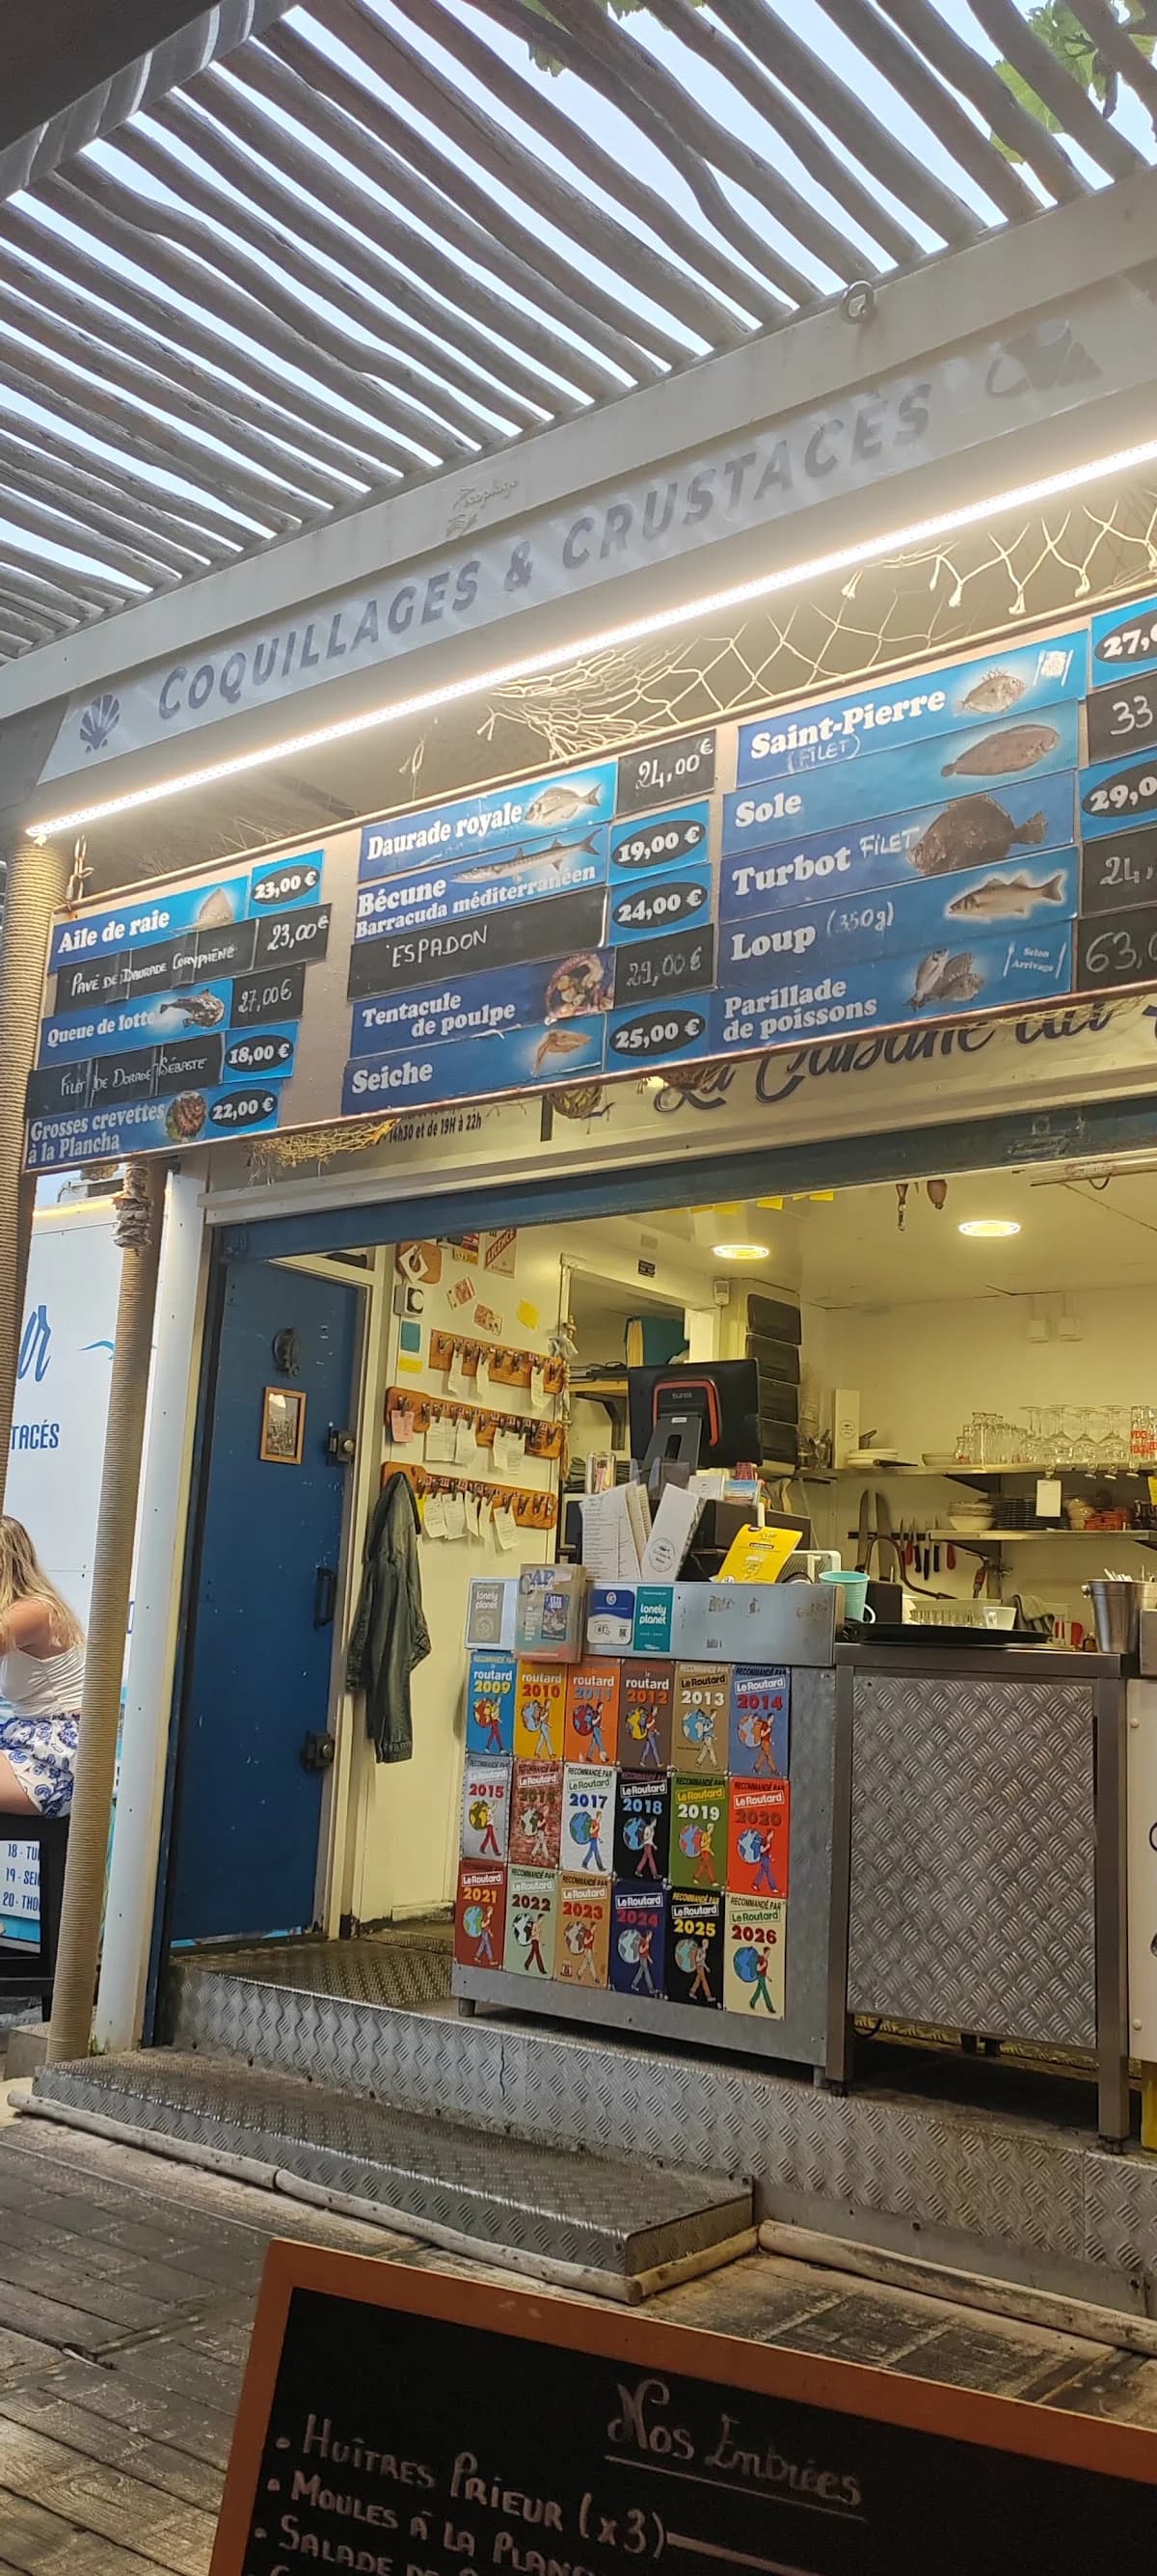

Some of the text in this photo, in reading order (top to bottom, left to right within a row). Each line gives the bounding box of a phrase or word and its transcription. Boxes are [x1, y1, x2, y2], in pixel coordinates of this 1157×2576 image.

[158, 560, 481, 719] COQUILLAGES
[503, 541, 534, 592] &
[1110, 694, 1153, 735] 33
[750, 691, 946, 759] Saint-Pierre
[735, 793, 802, 827] Sole
[367, 801, 522, 860] Daurade royale
[618, 826, 700, 863] 19,00 €
[732, 846, 850, 896] Turbot
[254, 871, 317, 900] 23,00 €
[355, 865, 596, 938] Barracuda méditerranéen
[357, 879, 447, 917] Bécune
[618, 888, 702, 922] 24,00 €
[58, 909, 170, 953] Aile de raie
[392, 925, 488, 967] ESPADON
[731, 926, 816, 961] Loup
[724, 978, 847, 1019] Parillade
[363, 992, 461, 1027] Tentacule
[412, 1004, 516, 1038] de poulpe
[723, 998, 877, 1043] de poissons
[48, 1011, 156, 1048] Queue de lotte
[615, 1018, 700, 1048] 25,00 €
[229, 1044, 290, 1065] 18,00 €
[352, 1061, 433, 1094] Seiche
[212, 1098, 274, 1121] 22,00 €
[30, 1102, 166, 1142] Grosses crevettes
[416, 1124, 425, 1138] et
[427, 1120, 438, 1136] de
[441, 1116, 456, 1134] 19H
[458, 1114, 464, 1131] à
[467, 1112, 482, 1130] 22h
[28, 1131, 120, 1164] à la Plancha
[640, 1604, 666, 1615] lonely
[639, 1615, 666, 1625] planet
[473, 1670, 512, 1681] routard
[522, 1673, 561, 1684] routard
[573, 1676, 614, 1687] routard
[626, 1677, 669, 1690] routard
[681, 1674, 726, 1689] Le Routard
[473, 1680, 511, 1695] 2009
[523, 1684, 560, 1697] 2010
[575, 1687, 612, 1701] 2011
[737, 1678, 784, 1693] Le Routard
[627, 1690, 669, 1705] 2012
[681, 1690, 725, 1706] 2013
[737, 1695, 783, 1711] 2014
[519, 1774, 556, 1786] Le Routard
[569, 1777, 610, 1791] Le Routard
[469, 1783, 504, 1799] 2015
[622, 1782, 665, 1796] Le Routard
[677, 1788, 723, 1802] Le Routard
[570, 1793, 608, 1808] 2017
[622, 1799, 662, 1814] 2018
[736, 1792, 783, 1806] Le Routard
[678, 1804, 720, 1821] 2019
[737, 1810, 783, 1827] 2020
[8, 1843, 17, 1858] 18
[6, 1867, 15, 1883] 19
[463, 1873, 501, 1885] Le Routard
[521, 1880, 553, 1890] Routard
[563, 1887, 605, 1899] Le Routard
[3, 1891, 14, 1908] 20
[463, 1887, 498, 1903] 2021
[511, 1894, 551, 1912] 2022
[617, 1896, 661, 1907] Le Routard
[563, 1902, 603, 1919] 2023
[674, 1905, 717, 1917] Le Routard
[731, 1897, 781, 1911] RECOMMANDÉ PAR
[617, 1911, 659, 1927] 2024
[732, 1909, 779, 1922] Le Routard
[674, 1919, 716, 1937] 2025
[731, 1925, 777, 1944] 2026
[607, 2378, 695, 2459] Nos
[291, 2470, 398, 2529] MOULES
[444, 2521, 475, 2557] LA
